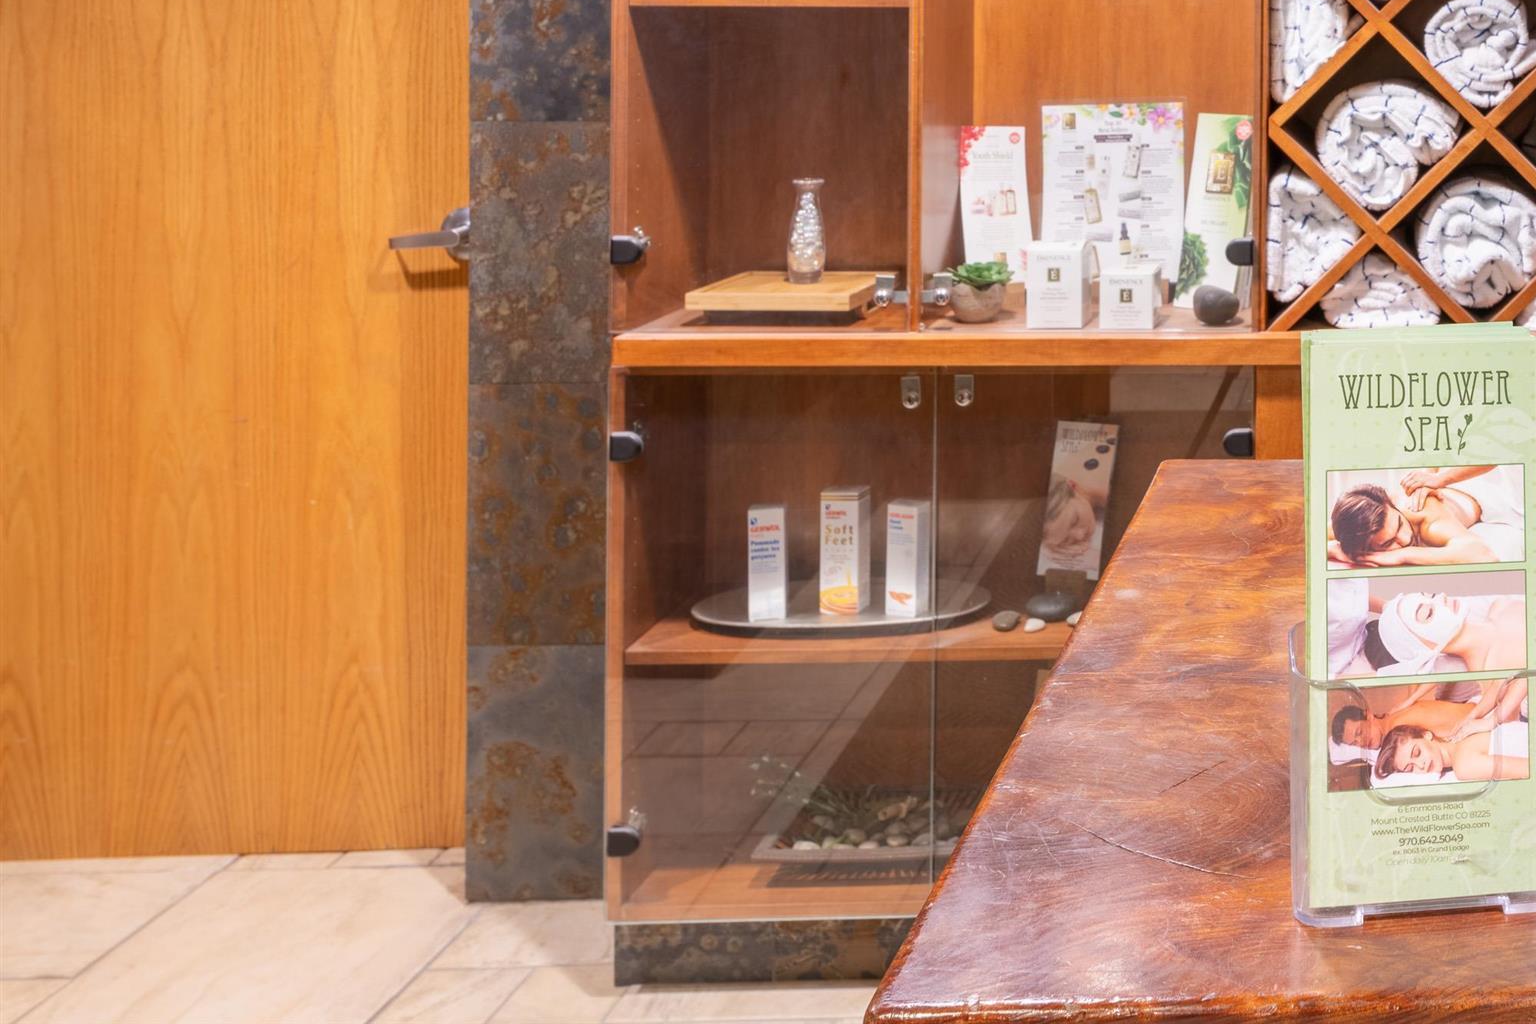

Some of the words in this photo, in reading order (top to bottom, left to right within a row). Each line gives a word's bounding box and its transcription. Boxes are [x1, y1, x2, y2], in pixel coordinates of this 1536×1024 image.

[1338, 370, 1512, 410] WILDFLOWER
[1404, 415, 1452, 453] SPA
[824, 523, 854, 535] Soft
[824, 535, 854, 545] Feet
[1404, 804, 1442, 814] Emmons
[1443, 802, 1464, 810] Road
[1371, 817, 1398, 826] Mount
[1399, 814, 1430, 823] Crested
[1431, 813, 1454, 821] Butte
[1455, 811, 1469, 820] CO
[1469, 809, 1492, 819] 81225
[1371, 821, 1490, 836] www.TheWildFlowerSpa.com
[1398, 833, 1464, 847] 970.642.5049
